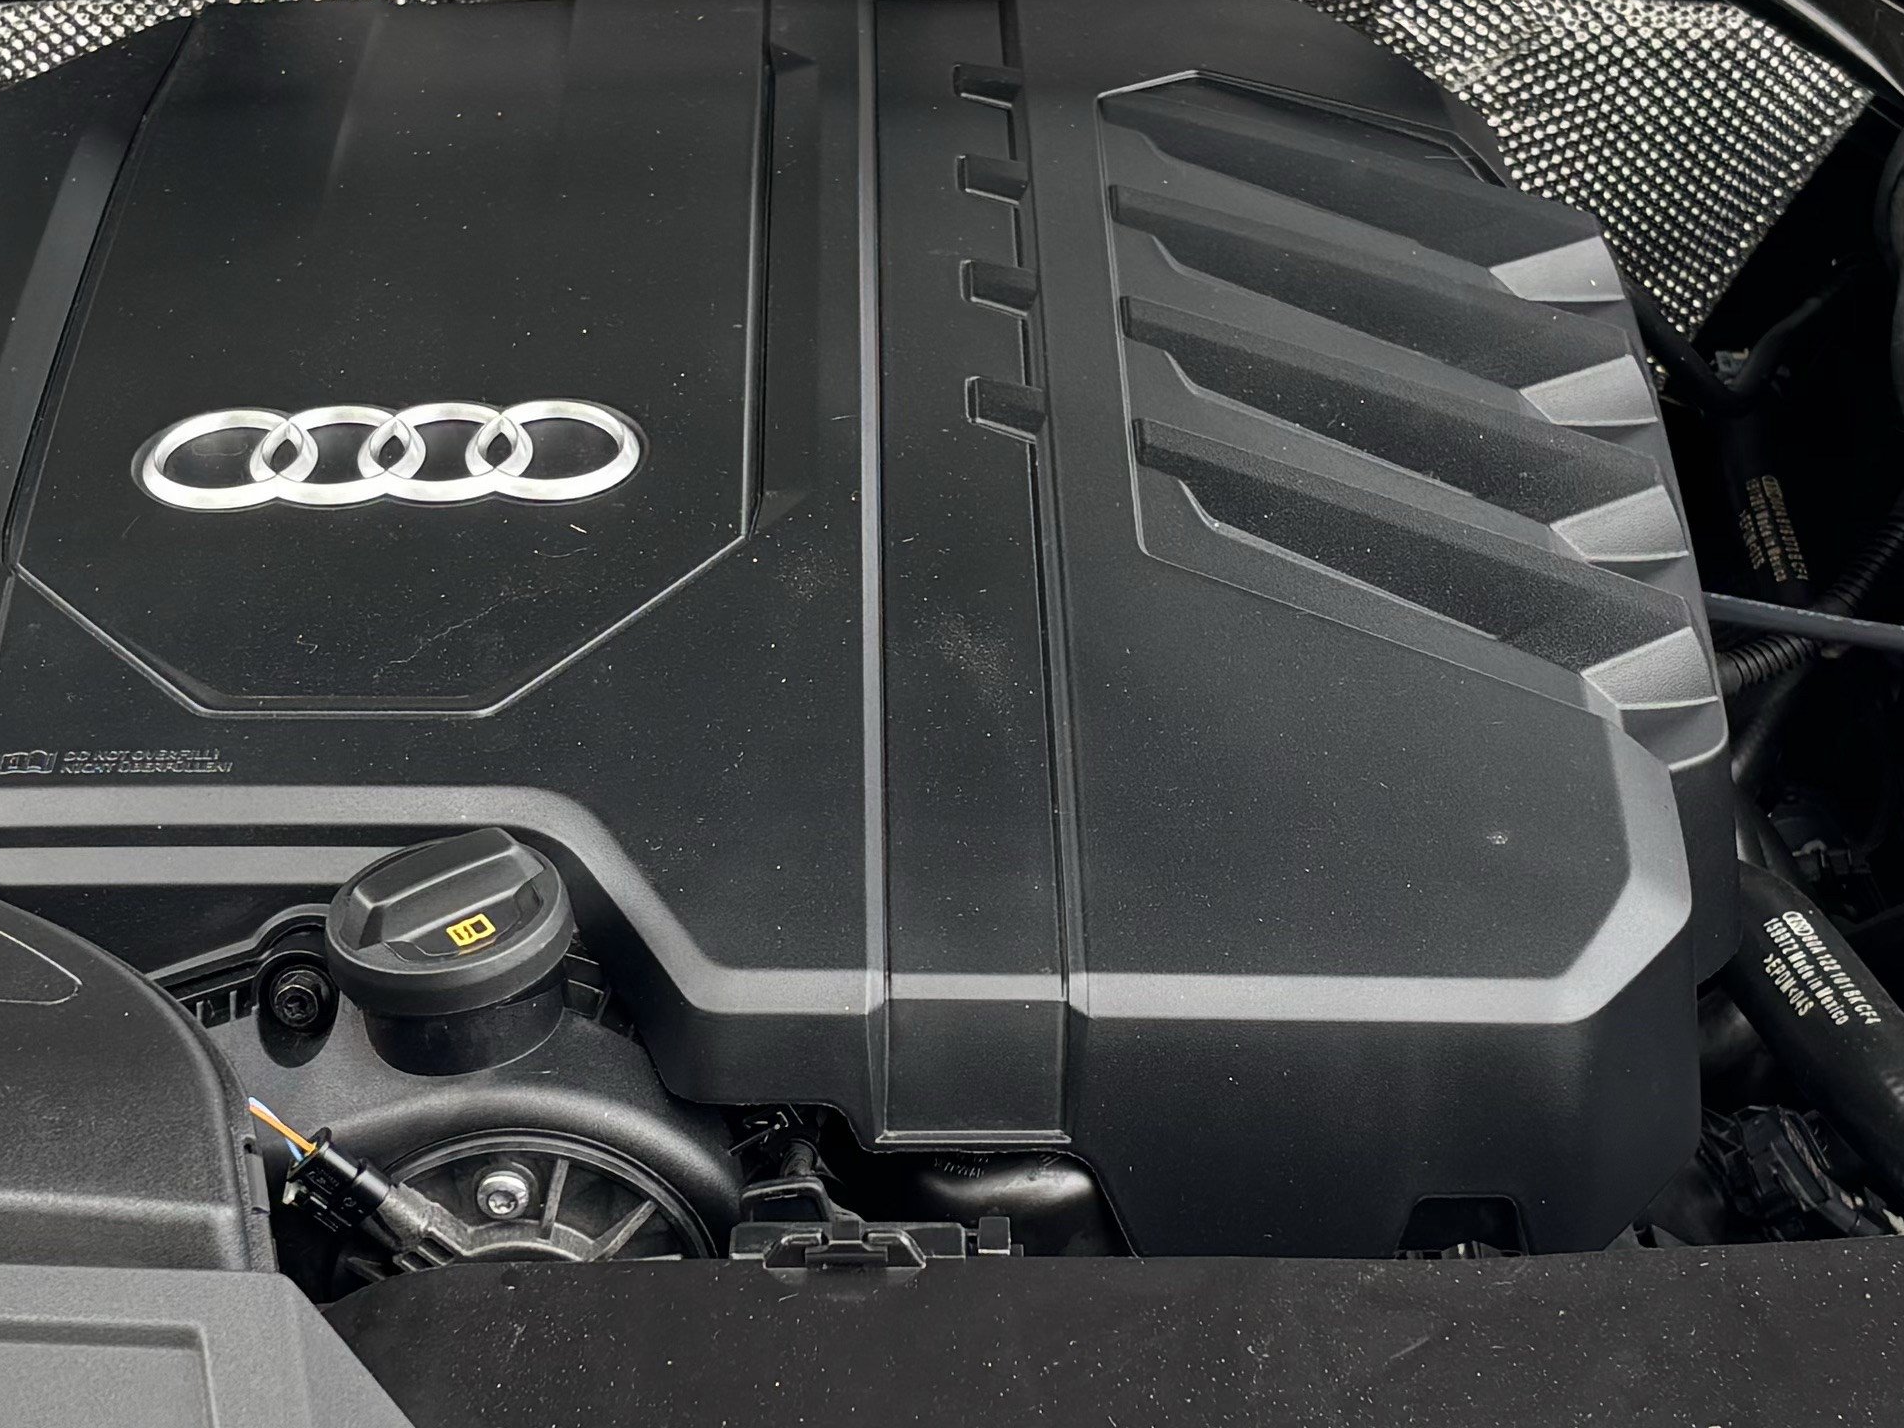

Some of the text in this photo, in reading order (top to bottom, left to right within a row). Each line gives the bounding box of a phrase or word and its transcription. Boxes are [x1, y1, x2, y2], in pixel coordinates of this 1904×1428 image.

[64, 751, 91, 761] DO
[93, 750, 131, 761] NOT
[60, 762, 116, 774] NICHT
[1816, 953, 1842, 972] 122
[1829, 972, 1855, 990] 101
[1788, 951, 1815, 980] Made
[1806, 975, 1823, 991] in
[1815, 986, 1849, 1025] Mexico
